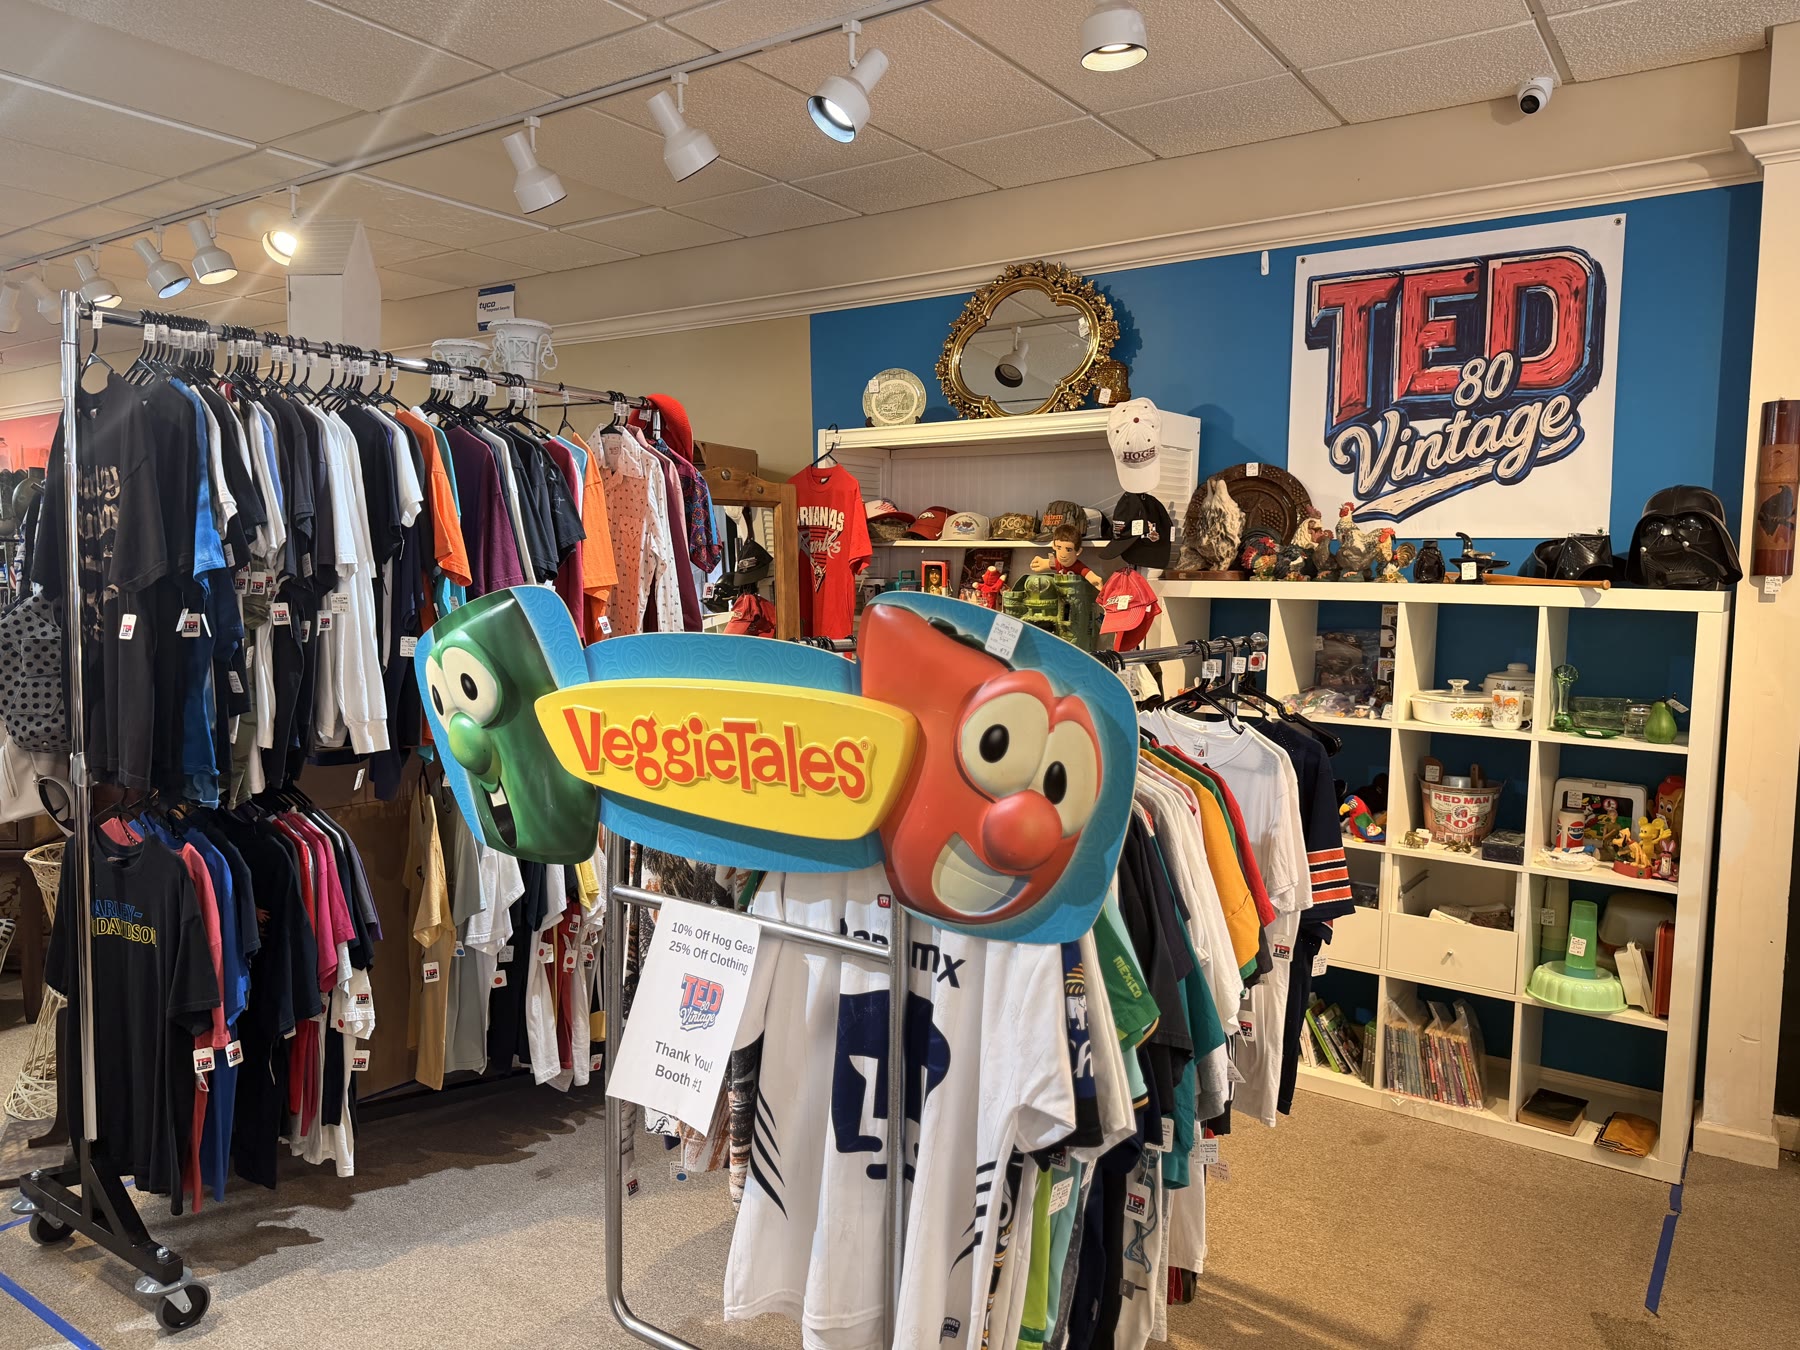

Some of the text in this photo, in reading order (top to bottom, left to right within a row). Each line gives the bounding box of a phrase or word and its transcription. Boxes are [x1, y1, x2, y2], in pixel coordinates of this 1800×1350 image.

[479, 301, 496, 311] tyco
[1305, 246, 1607, 440] TED
[1453, 351, 1516, 408] 80
[1330, 393, 1576, 496] Vintage
[1434, 792, 1490, 804] RED MAN
[671, 922, 755, 955] 10% Off Hog Gear
[669, 940, 749, 976] 25% Off Clothing
[681, 973, 724, 1013] TED
[679, 1006, 715, 1029] Vintage
[655, 1040, 714, 1074] Thank You!
[655, 1064, 702, 1093] Booth #1
